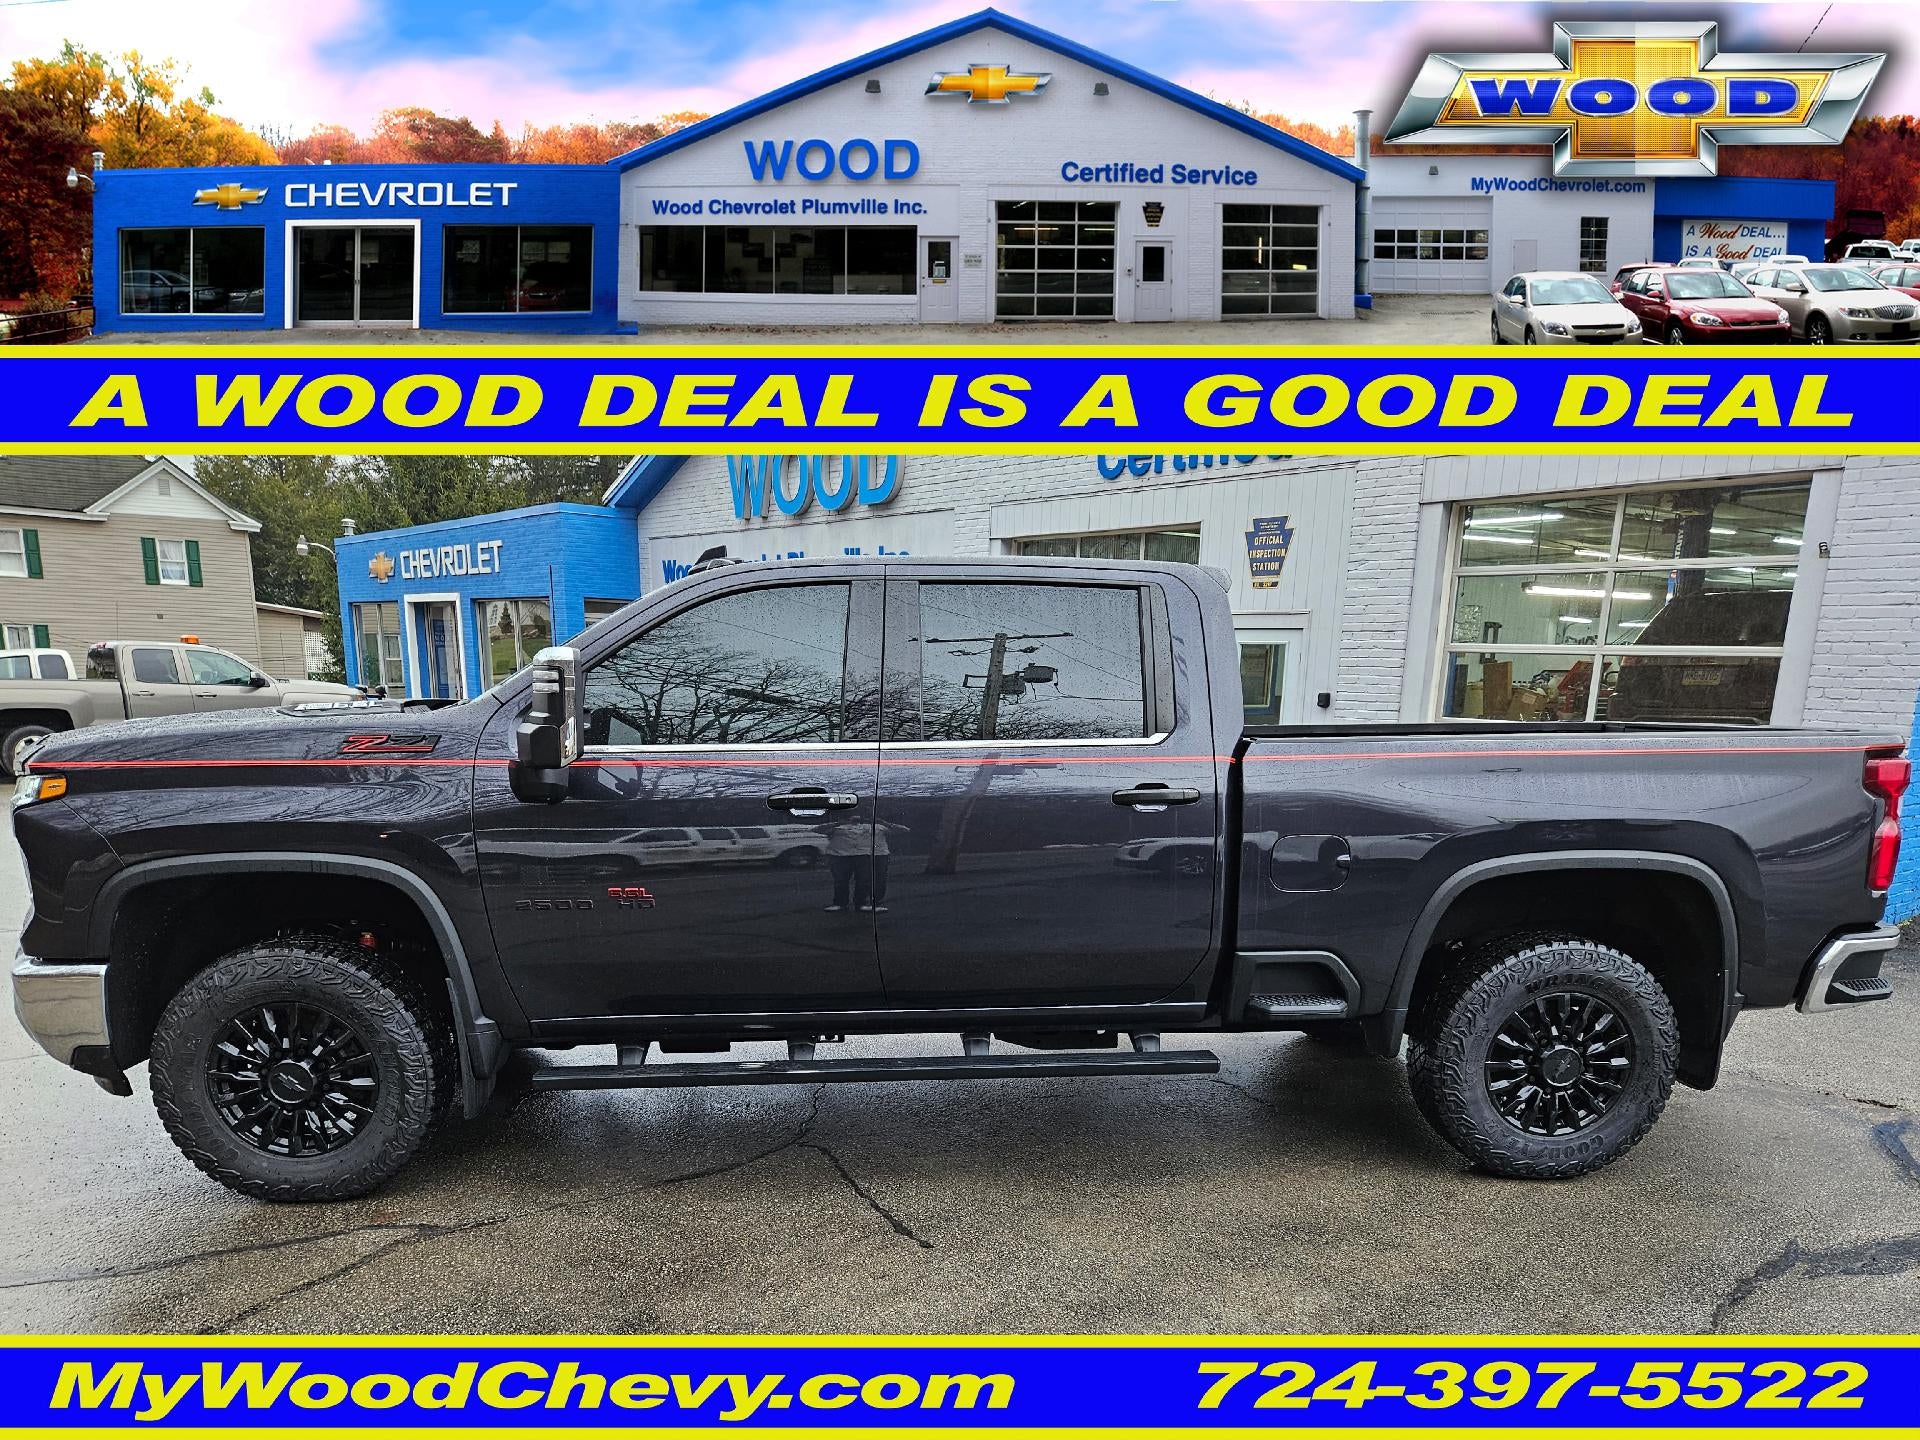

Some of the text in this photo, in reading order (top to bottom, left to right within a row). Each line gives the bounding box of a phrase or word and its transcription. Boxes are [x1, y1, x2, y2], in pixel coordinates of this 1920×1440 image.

[741, 137, 921, 182] WOOD
[1061, 160, 1259, 186] Certified Service
[1470, 175, 1647, 195] MyWoodChevrolet.com
[284, 182, 518, 208] CHEVROLET
[651, 198, 928, 216] Wood Chevrolet Plumville Inc.
[1686, 224, 1696, 237] A
[1699, 222, 1743, 240] Wood
[1685, 245, 1699, 257] IS
[1703, 246, 1712, 257] A
[1715, 243, 1755, 260] Good
[727, 455, 906, 519] WOOD
[1254, 535, 1284, 546] OFFICIAL
[400, 540, 503, 579] CHEVROLET
[1249, 548, 1286, 559] INSPECTION
[1252, 561, 1280, 571] STATION
[338, 734, 442, 754] Z71
[514, 898, 656, 911] 2500 HD
